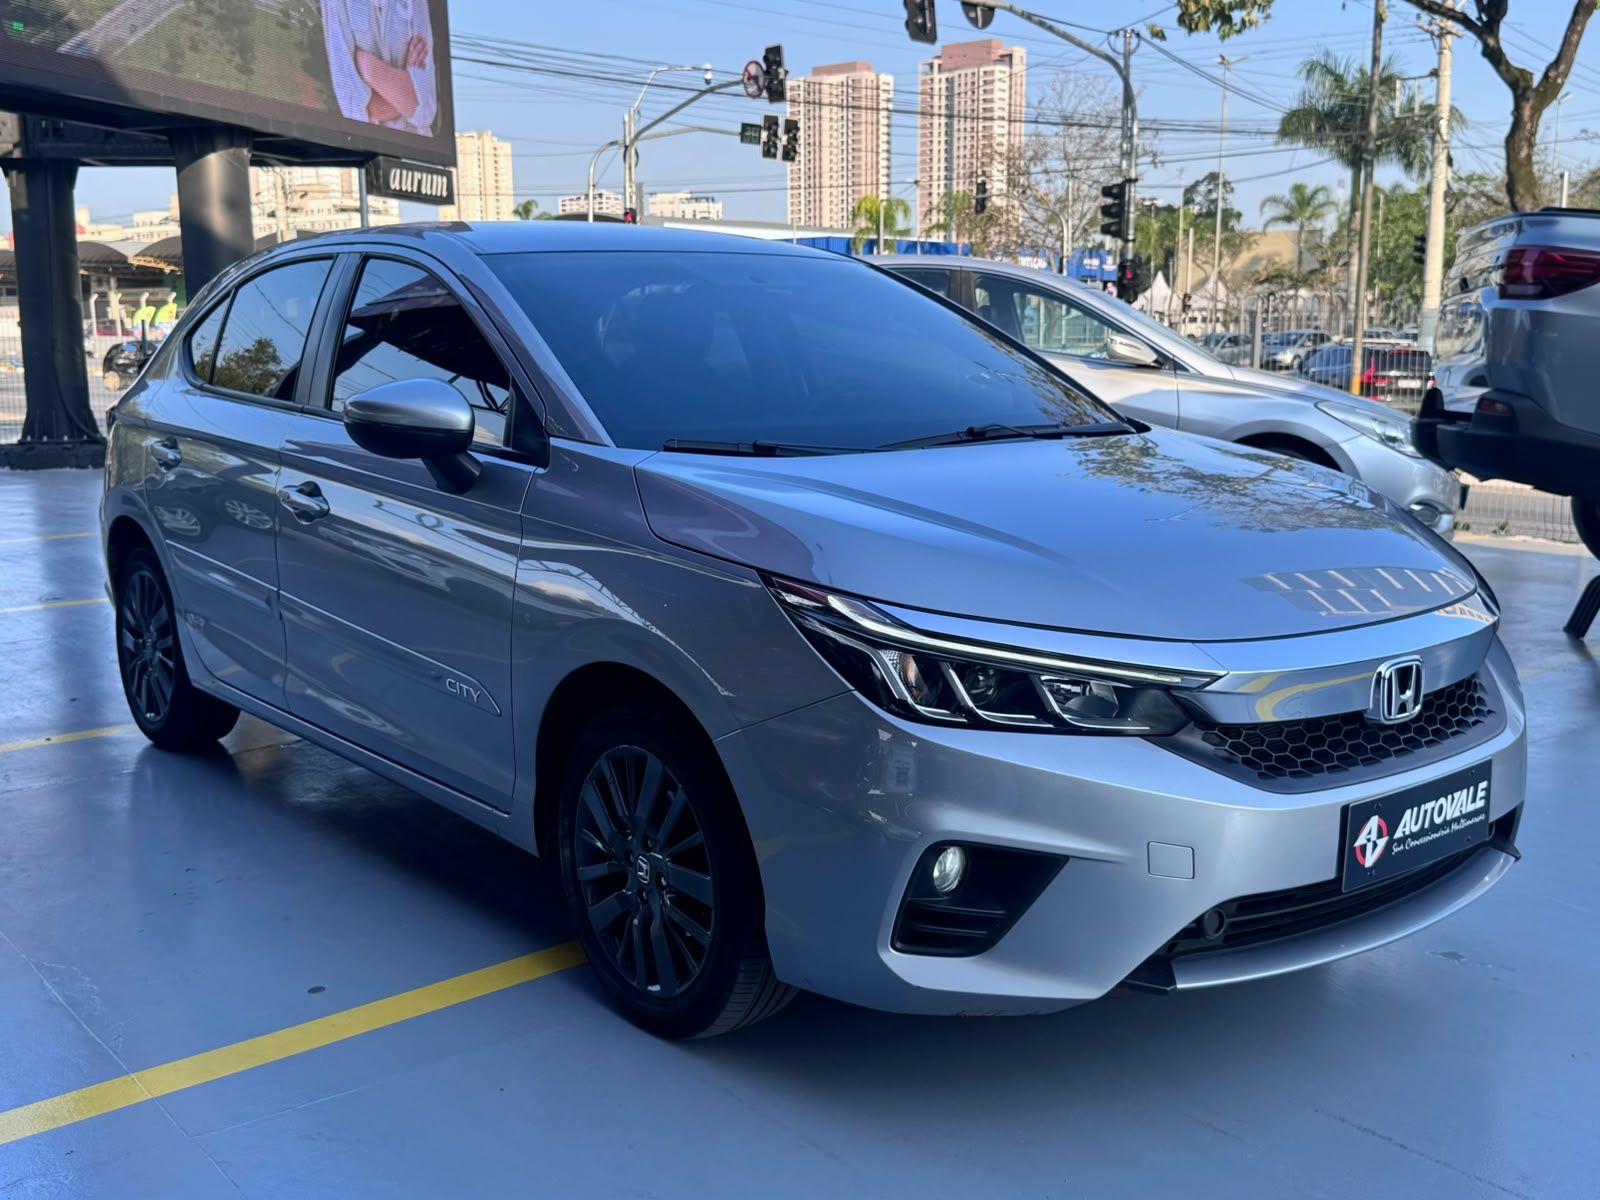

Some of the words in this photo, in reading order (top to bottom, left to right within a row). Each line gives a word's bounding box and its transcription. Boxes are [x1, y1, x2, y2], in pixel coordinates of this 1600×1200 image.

[389, 167, 448, 198] aurum
[446, 678, 481, 703] CITY
[1392, 780, 1488, 839] AUTOVALE
